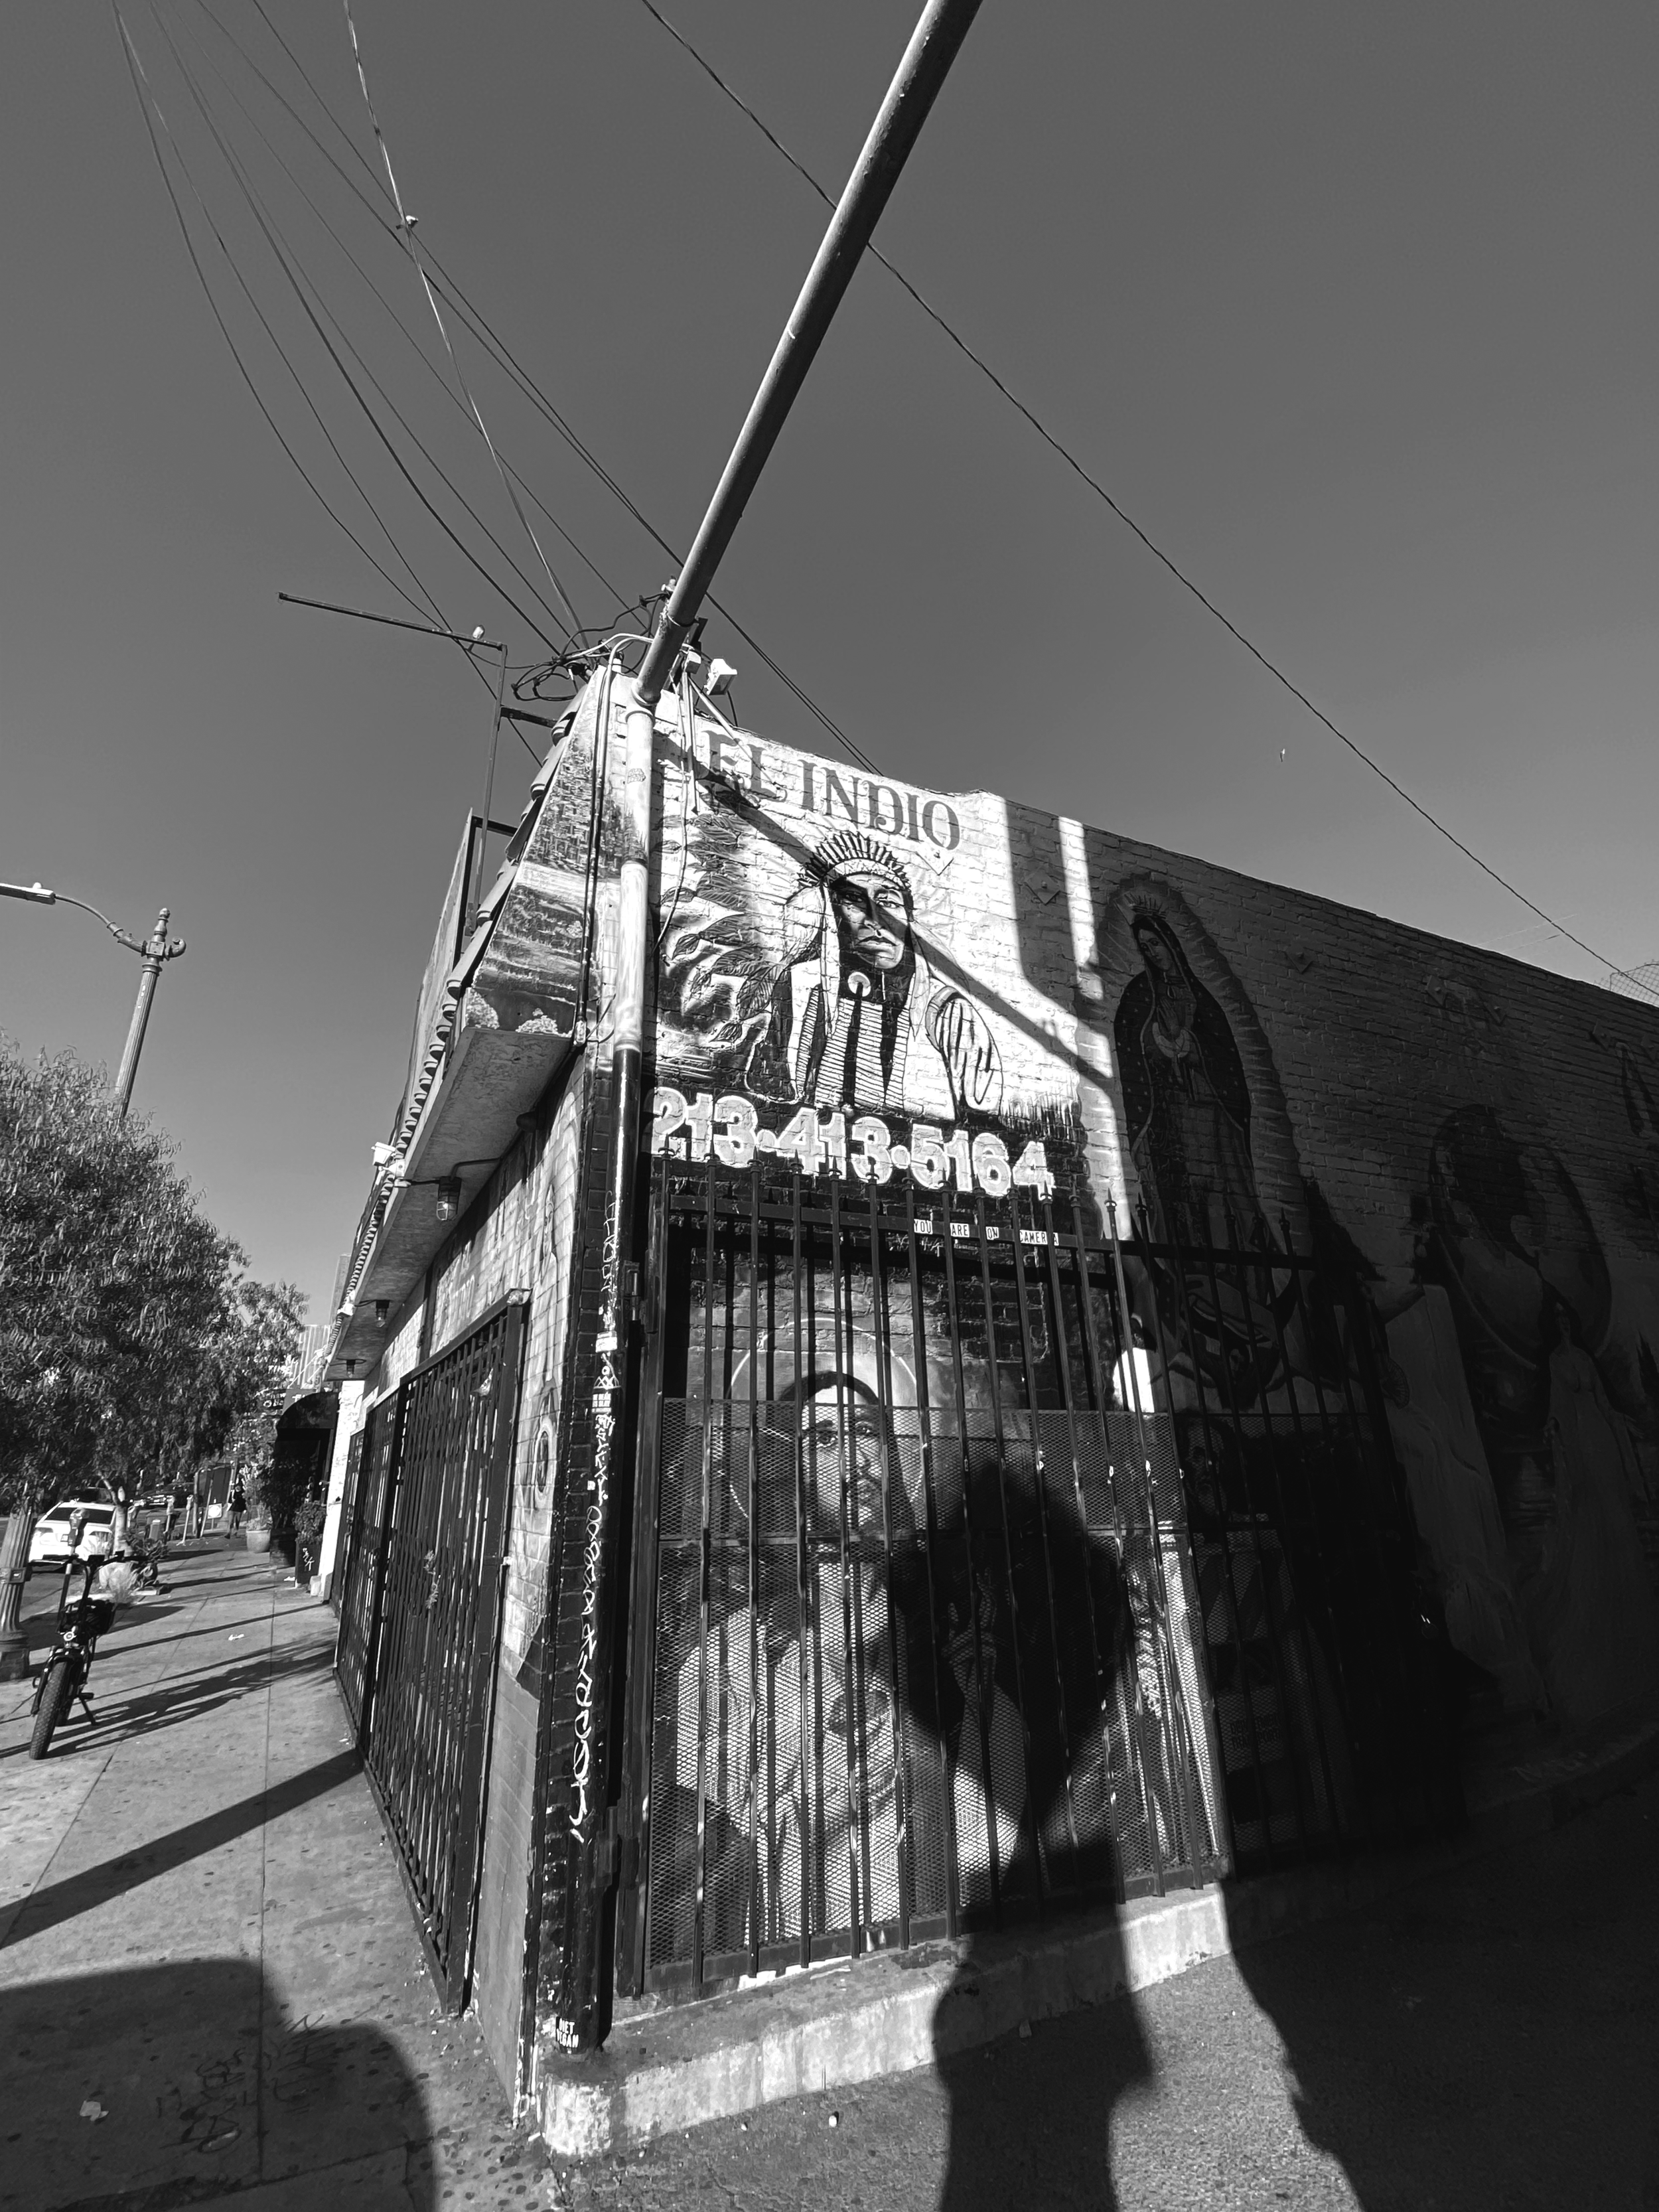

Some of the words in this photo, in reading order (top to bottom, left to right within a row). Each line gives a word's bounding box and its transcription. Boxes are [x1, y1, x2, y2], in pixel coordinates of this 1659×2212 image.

[700, 729, 788, 803] EL
[797, 759, 960, 851] INDIO
[915, 1220, 932, 1234] YOU
[952, 1224, 969, 1236] ARE
[987, 1227, 998, 1240] ON
[558, 2018, 575, 2035] DIET
